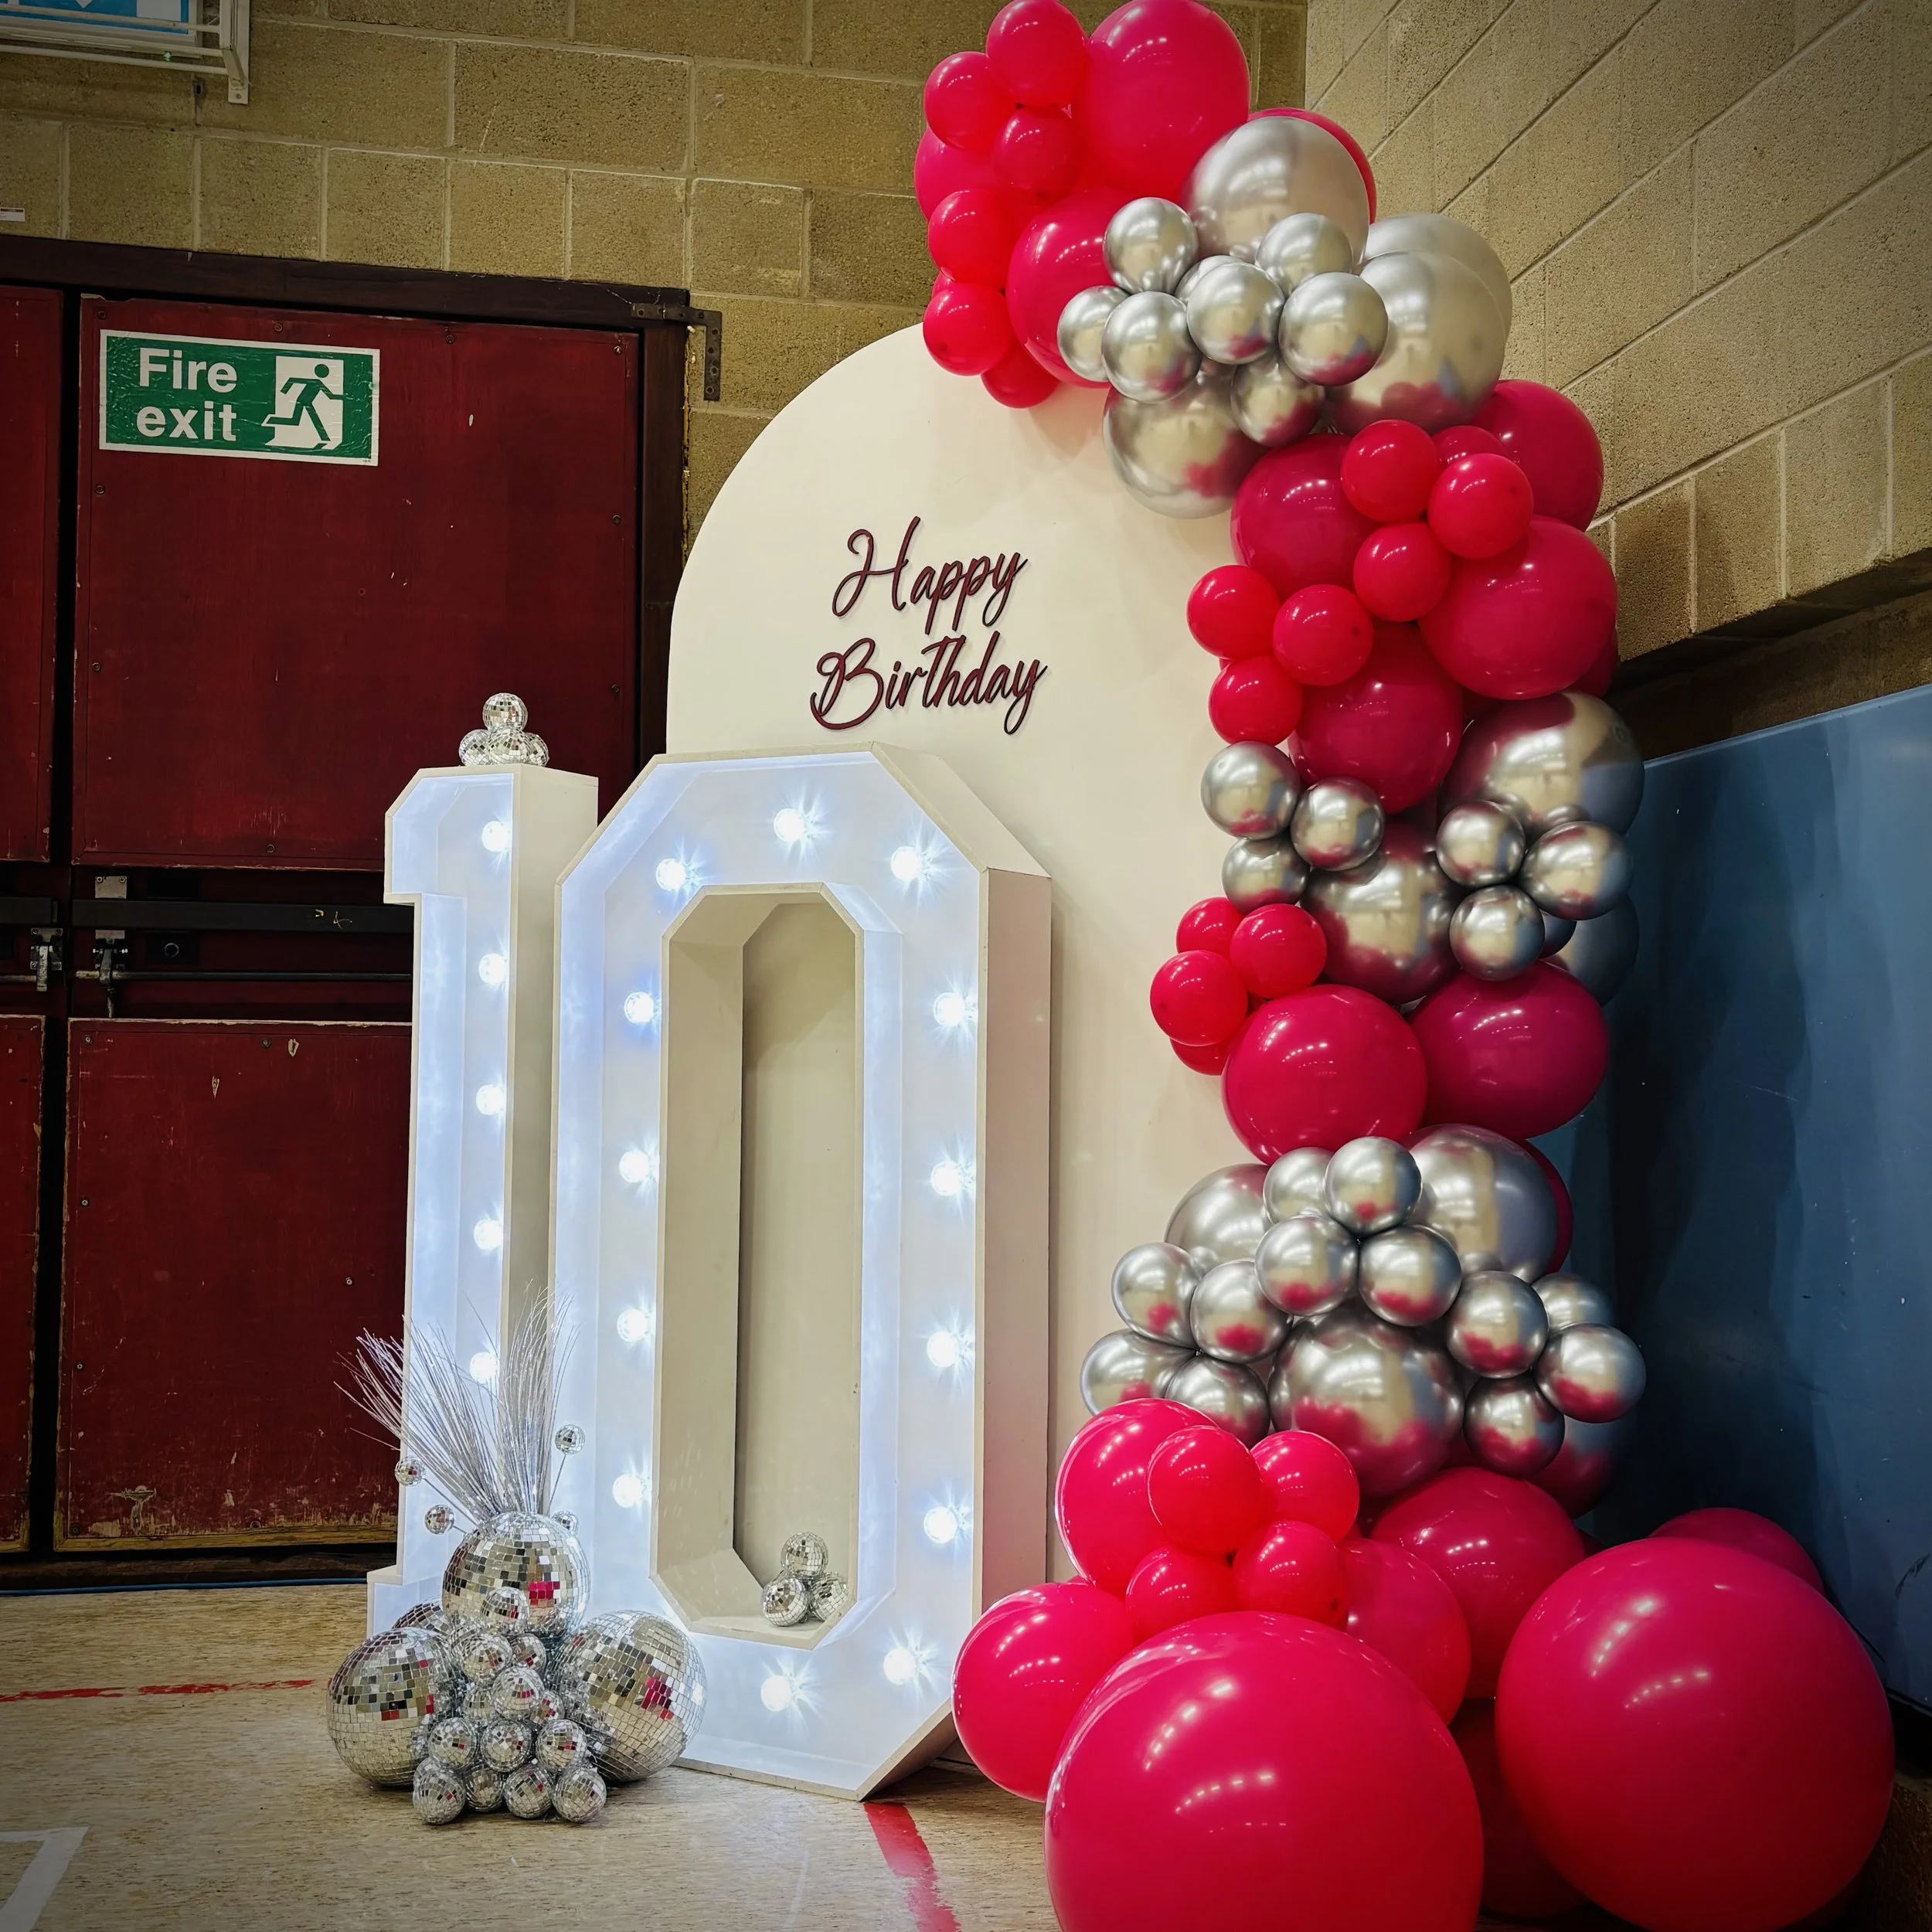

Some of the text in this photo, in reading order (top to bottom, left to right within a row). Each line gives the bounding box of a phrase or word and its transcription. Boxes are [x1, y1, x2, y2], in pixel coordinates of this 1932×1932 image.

[136, 400, 236, 441] exit
[138, 346, 237, 393] Fire
[832, 515, 1029, 635] Happy
[810, 631, 1048, 735] Birthday
[366, 740, 1052, 1799] 10
